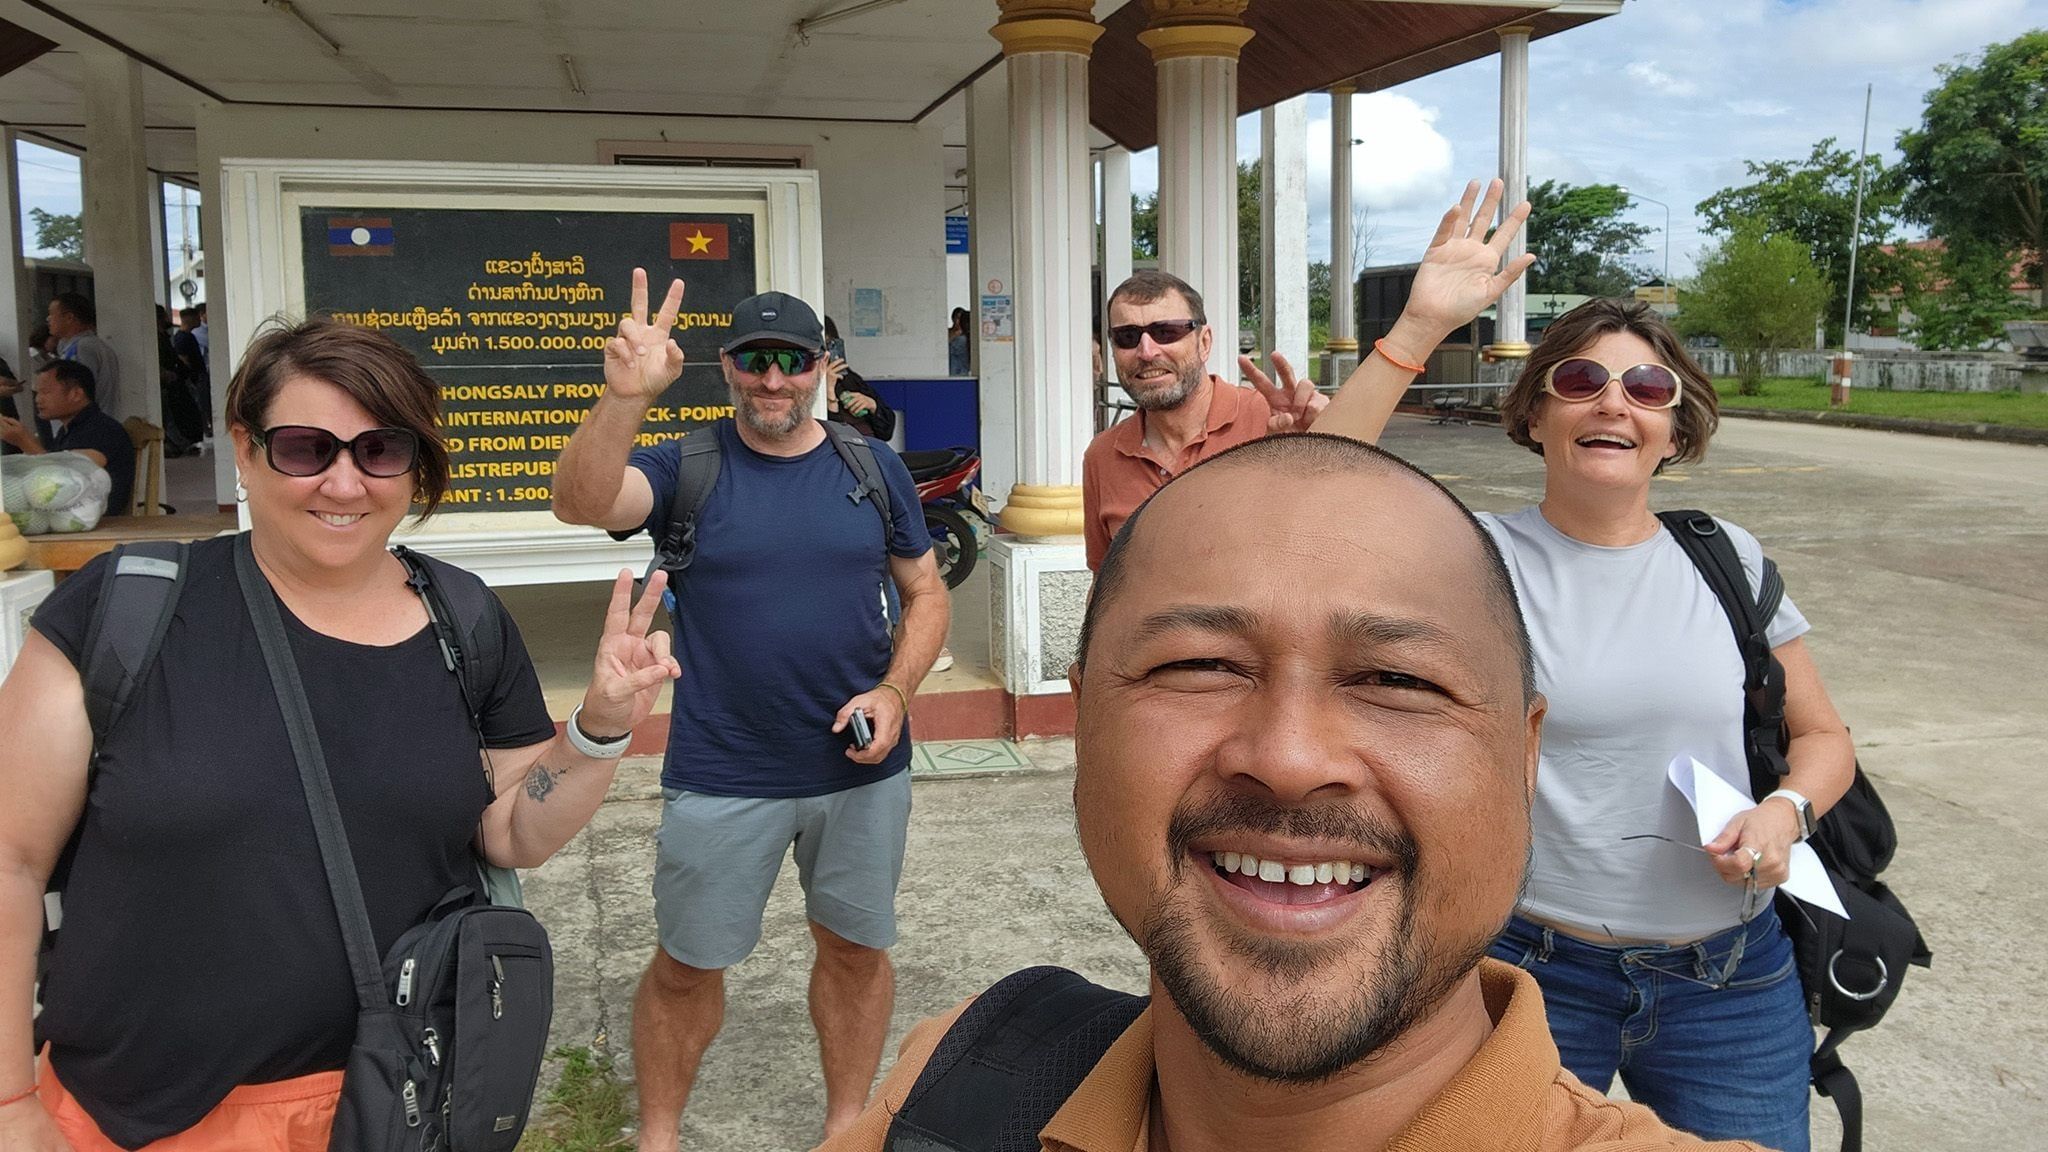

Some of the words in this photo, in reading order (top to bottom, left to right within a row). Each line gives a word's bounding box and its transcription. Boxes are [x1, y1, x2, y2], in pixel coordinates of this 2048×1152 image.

[485, 335, 614, 350] 1.500.000.00
[437, 383, 549, 401] HONGSALY
[553, 383, 606, 399] PROV
[448, 409, 591, 427] INTERNATIONA
[468, 436, 526, 452] FROM
[496, 486, 554, 501] 1.500.
